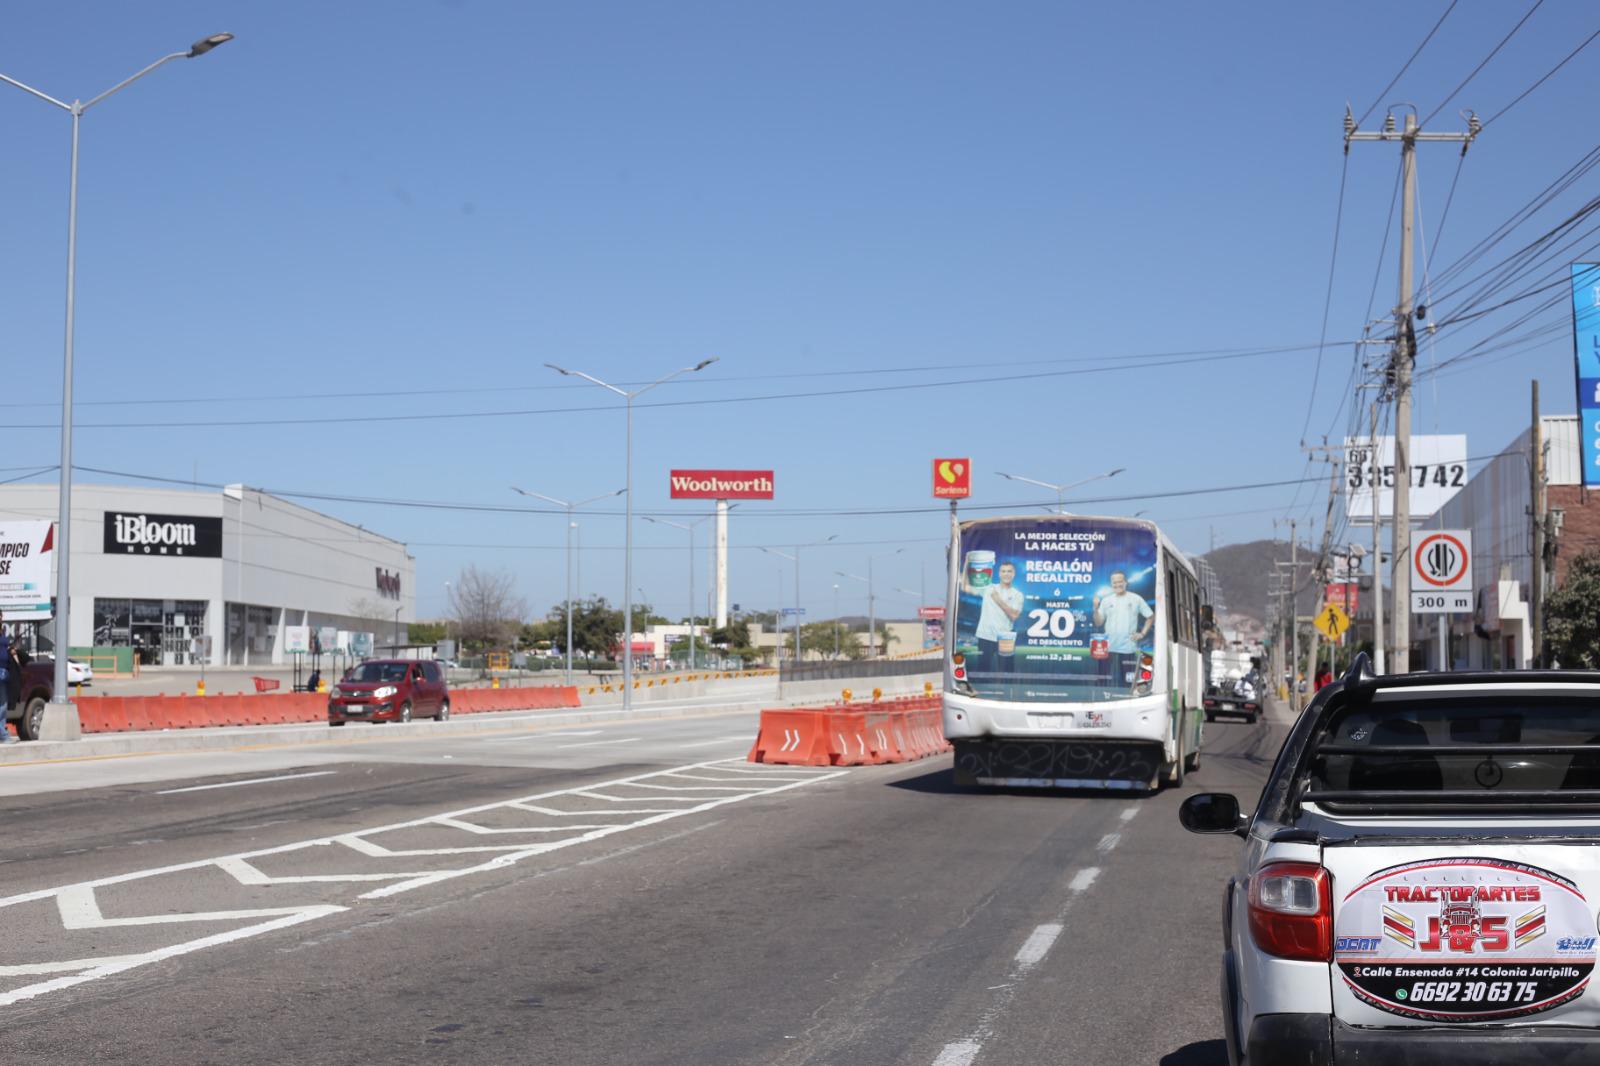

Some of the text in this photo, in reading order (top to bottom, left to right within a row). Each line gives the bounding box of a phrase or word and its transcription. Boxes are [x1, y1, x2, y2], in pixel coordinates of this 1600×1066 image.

[671, 477, 773, 492] Woolworth
[114, 514, 197, 545] iBloom
[1015, 531, 1106, 541] LA MEJOR SELECCIÓN
[127, 545, 183, 555] HOME
[1025, 540, 1095, 551] LA HACES TÚ
[1026, 558, 1093, 572] REGALÓN
[1026, 573, 1092, 583] REGALITRO
[1417, 597, 1467, 608] 300 m
[1039, 638, 1083, 646] DESCUENTO
[1384, 886, 1542, 902] TRACTOPARTES
[1362, 967, 1580, 979] Calle Ensenada #14 Colonia Jaripillo
[1410, 982, 1538, 1001] 6692 30 63 75
